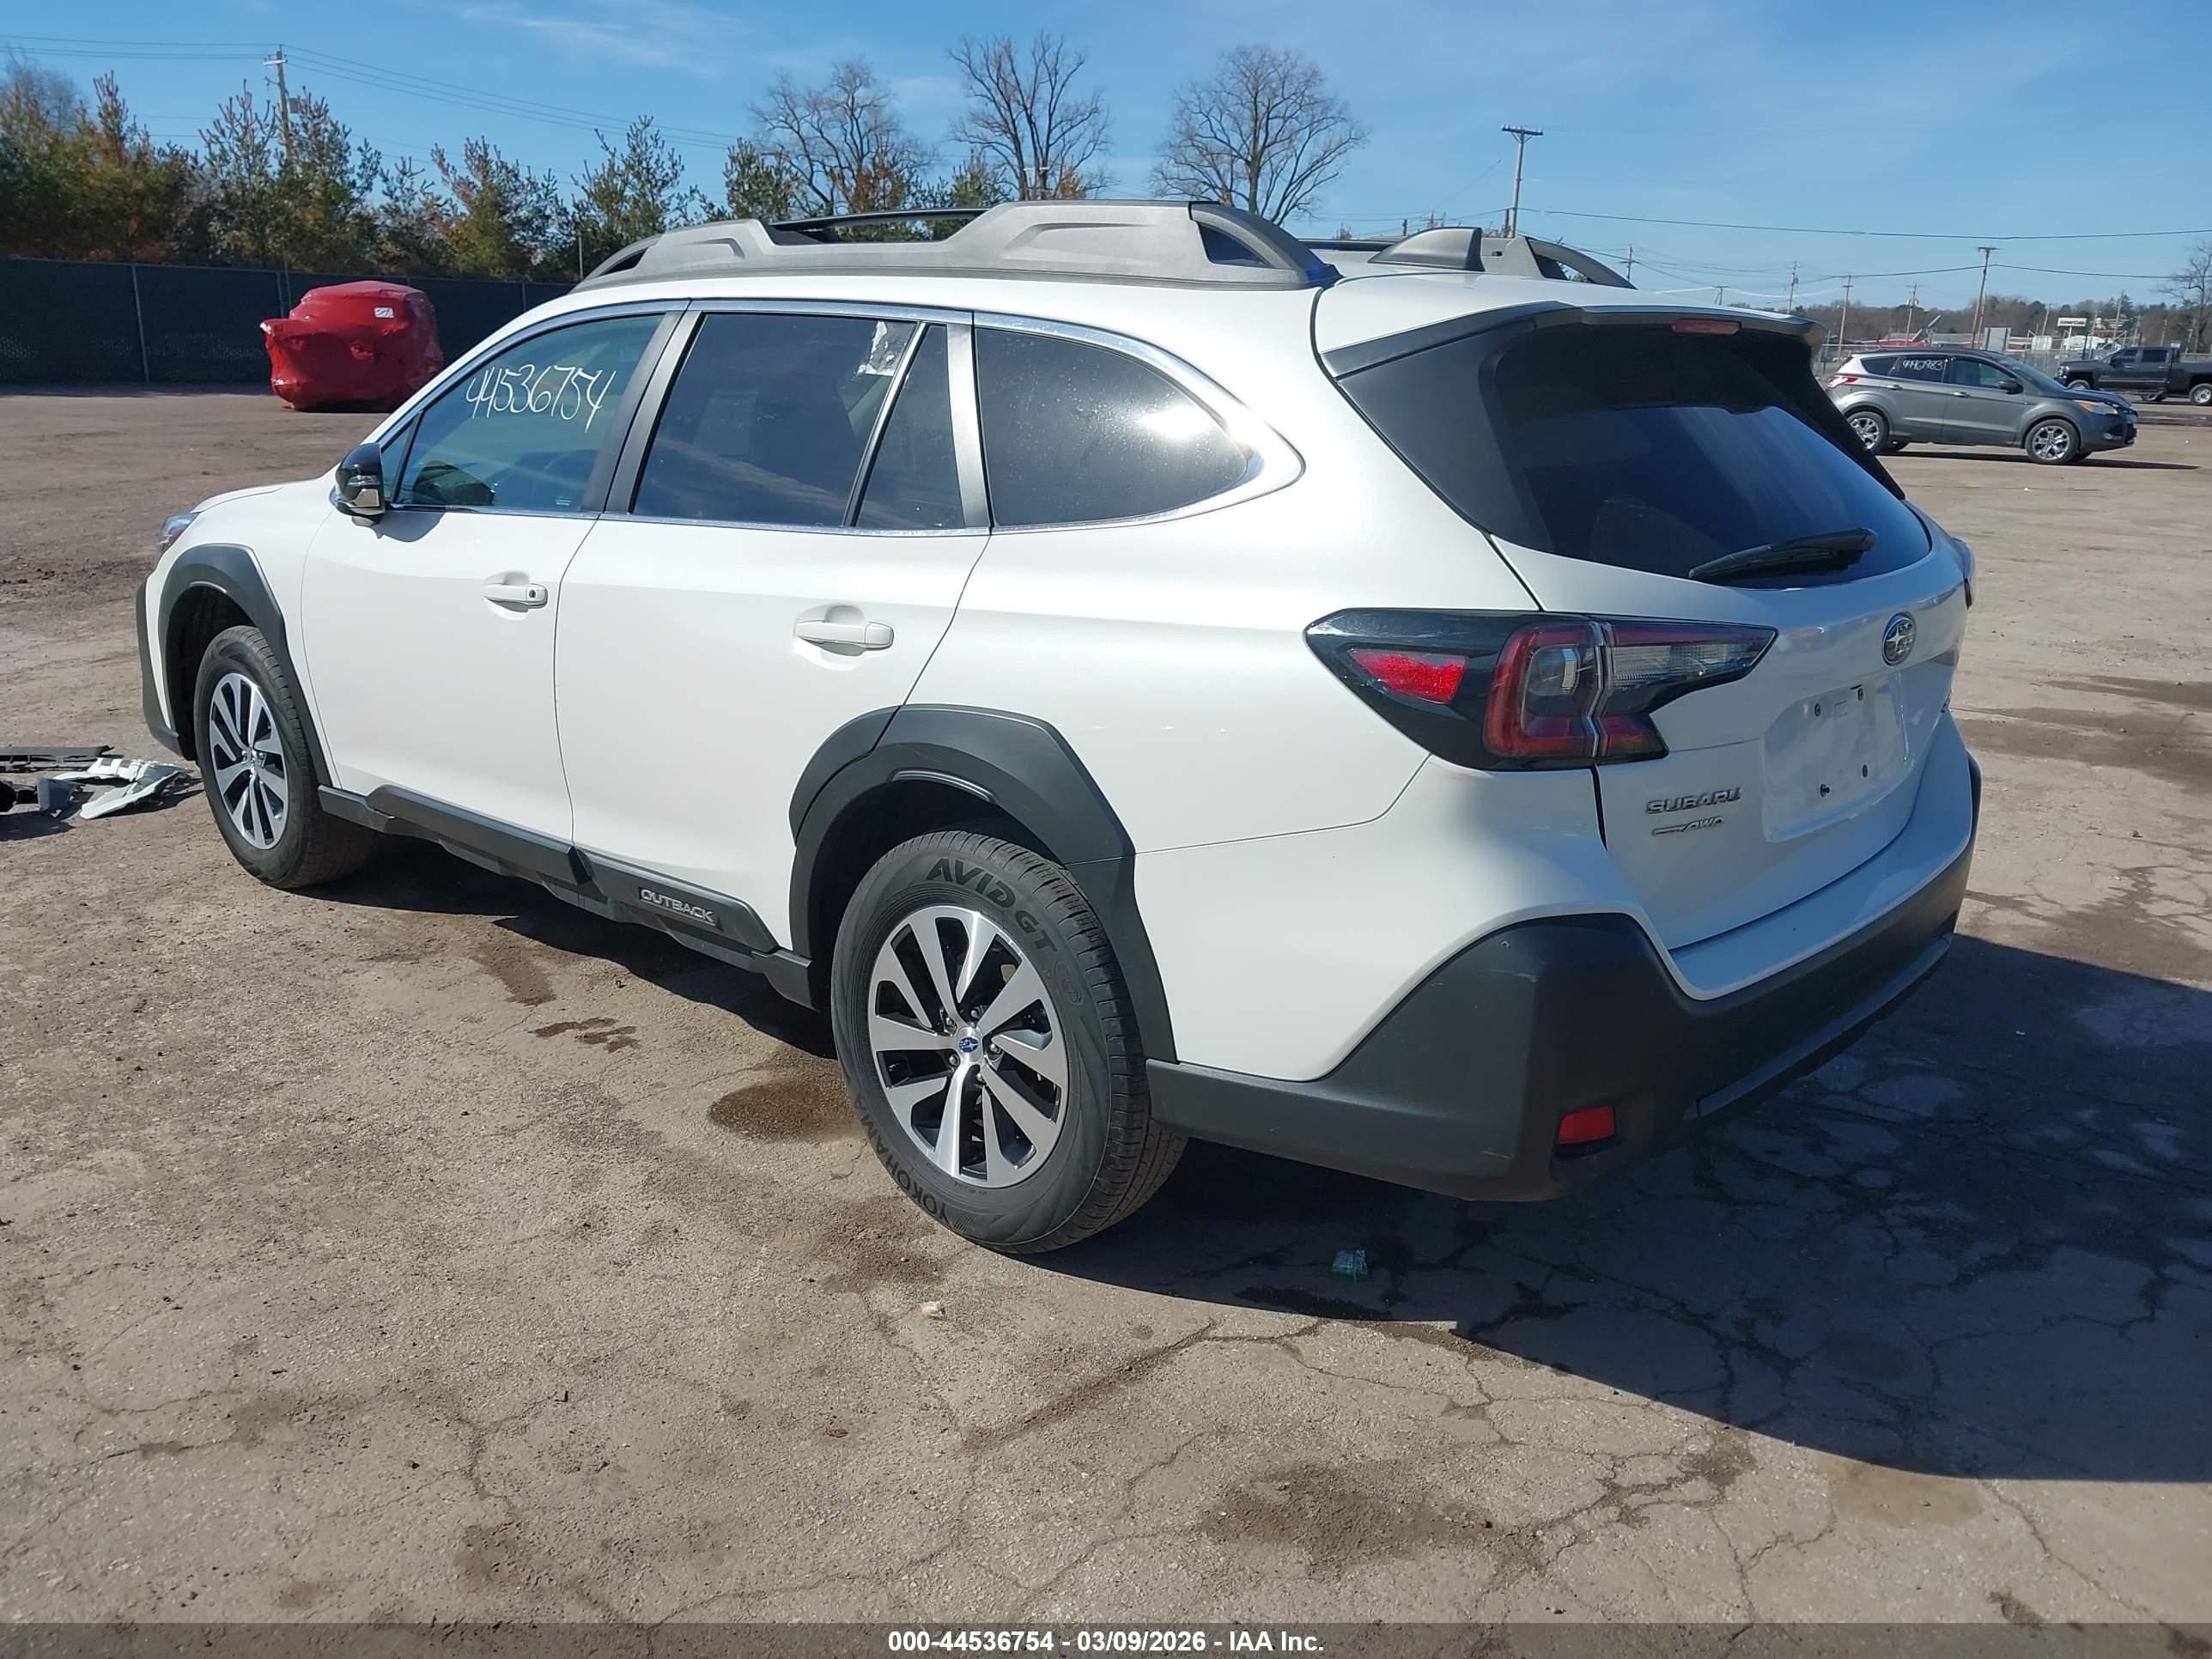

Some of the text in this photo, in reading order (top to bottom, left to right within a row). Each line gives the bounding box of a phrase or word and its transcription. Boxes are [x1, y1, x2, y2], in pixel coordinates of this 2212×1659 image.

[465, 363, 617, 434] 44536754
[1646, 787, 1743, 814] SUBARU
[641, 888, 714, 922] OUTBACK
[926, 858, 1058, 952] AVID GT
